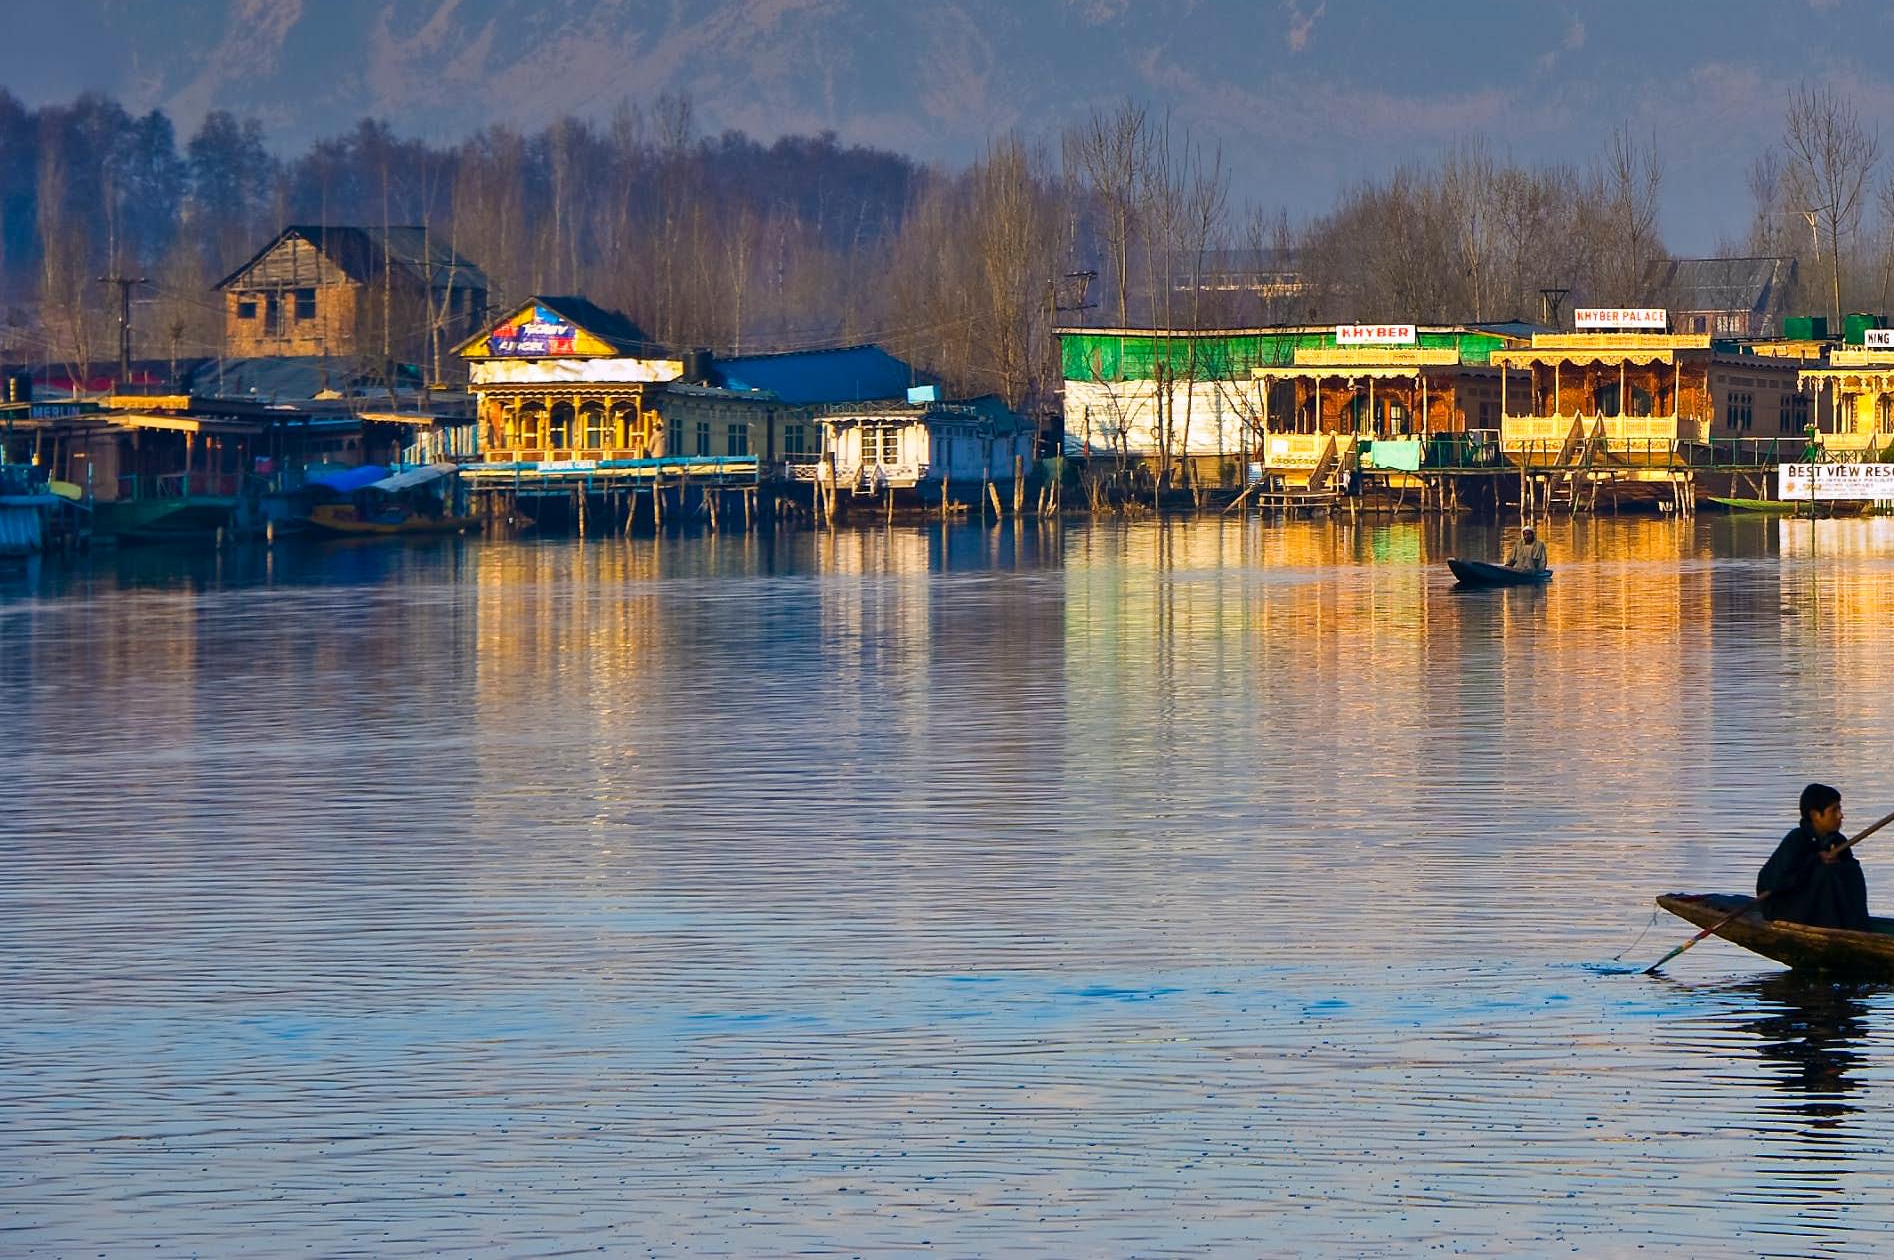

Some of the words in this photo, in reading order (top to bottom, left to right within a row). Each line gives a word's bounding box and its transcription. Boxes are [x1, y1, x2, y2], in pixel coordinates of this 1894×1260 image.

[1577, 311, 1619, 321] KHYBER
[1622, 311, 1664, 321] PALACE
[1342, 327, 1408, 338] KHYBER
[1868, 333, 1890, 344] KING
[1788, 466, 1822, 477] BEST
[1827, 466, 1860, 477] VIEW
